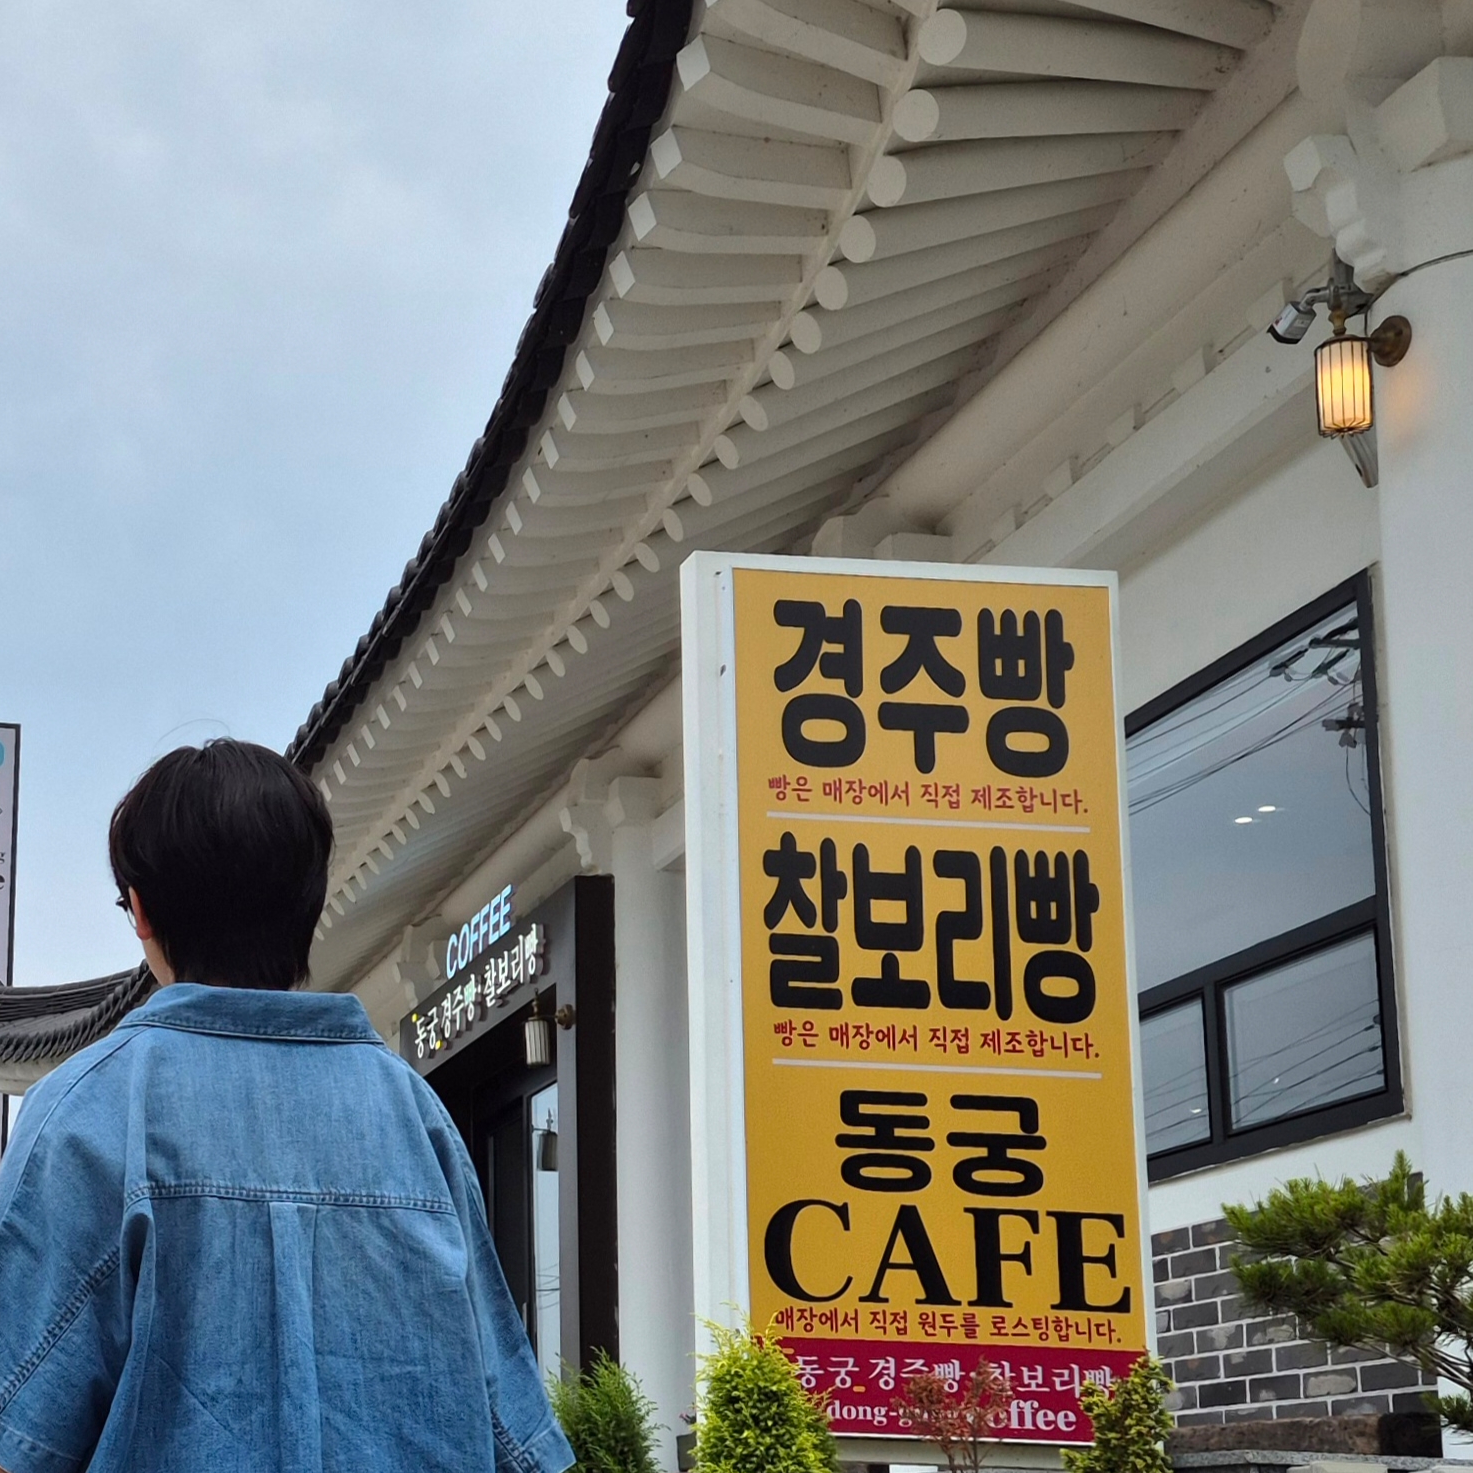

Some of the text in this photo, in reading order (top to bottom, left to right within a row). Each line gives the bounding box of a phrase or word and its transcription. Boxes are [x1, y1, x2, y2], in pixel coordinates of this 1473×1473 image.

[774, 599, 1074, 777] 경주빵
[768, 775, 1089, 815] 빵은 매장에서 직접 제조합니다.
[446, 884, 512, 980] COFFEE
[763, 831, 1100, 1024] 찰보리빵
[414, 1006, 439, 1059] 동궁
[774, 1020, 1100, 1060] 빵은 매장에서 직접 제조합니다.
[835, 1090, 1047, 1197] 동궁
[763, 1199, 1131, 1314] CAFE
[776, 1306, 1122, 1345] 매장에서 직접 원두를 로스팅합니다.
[793, 1356, 860, 1389] 동궁
